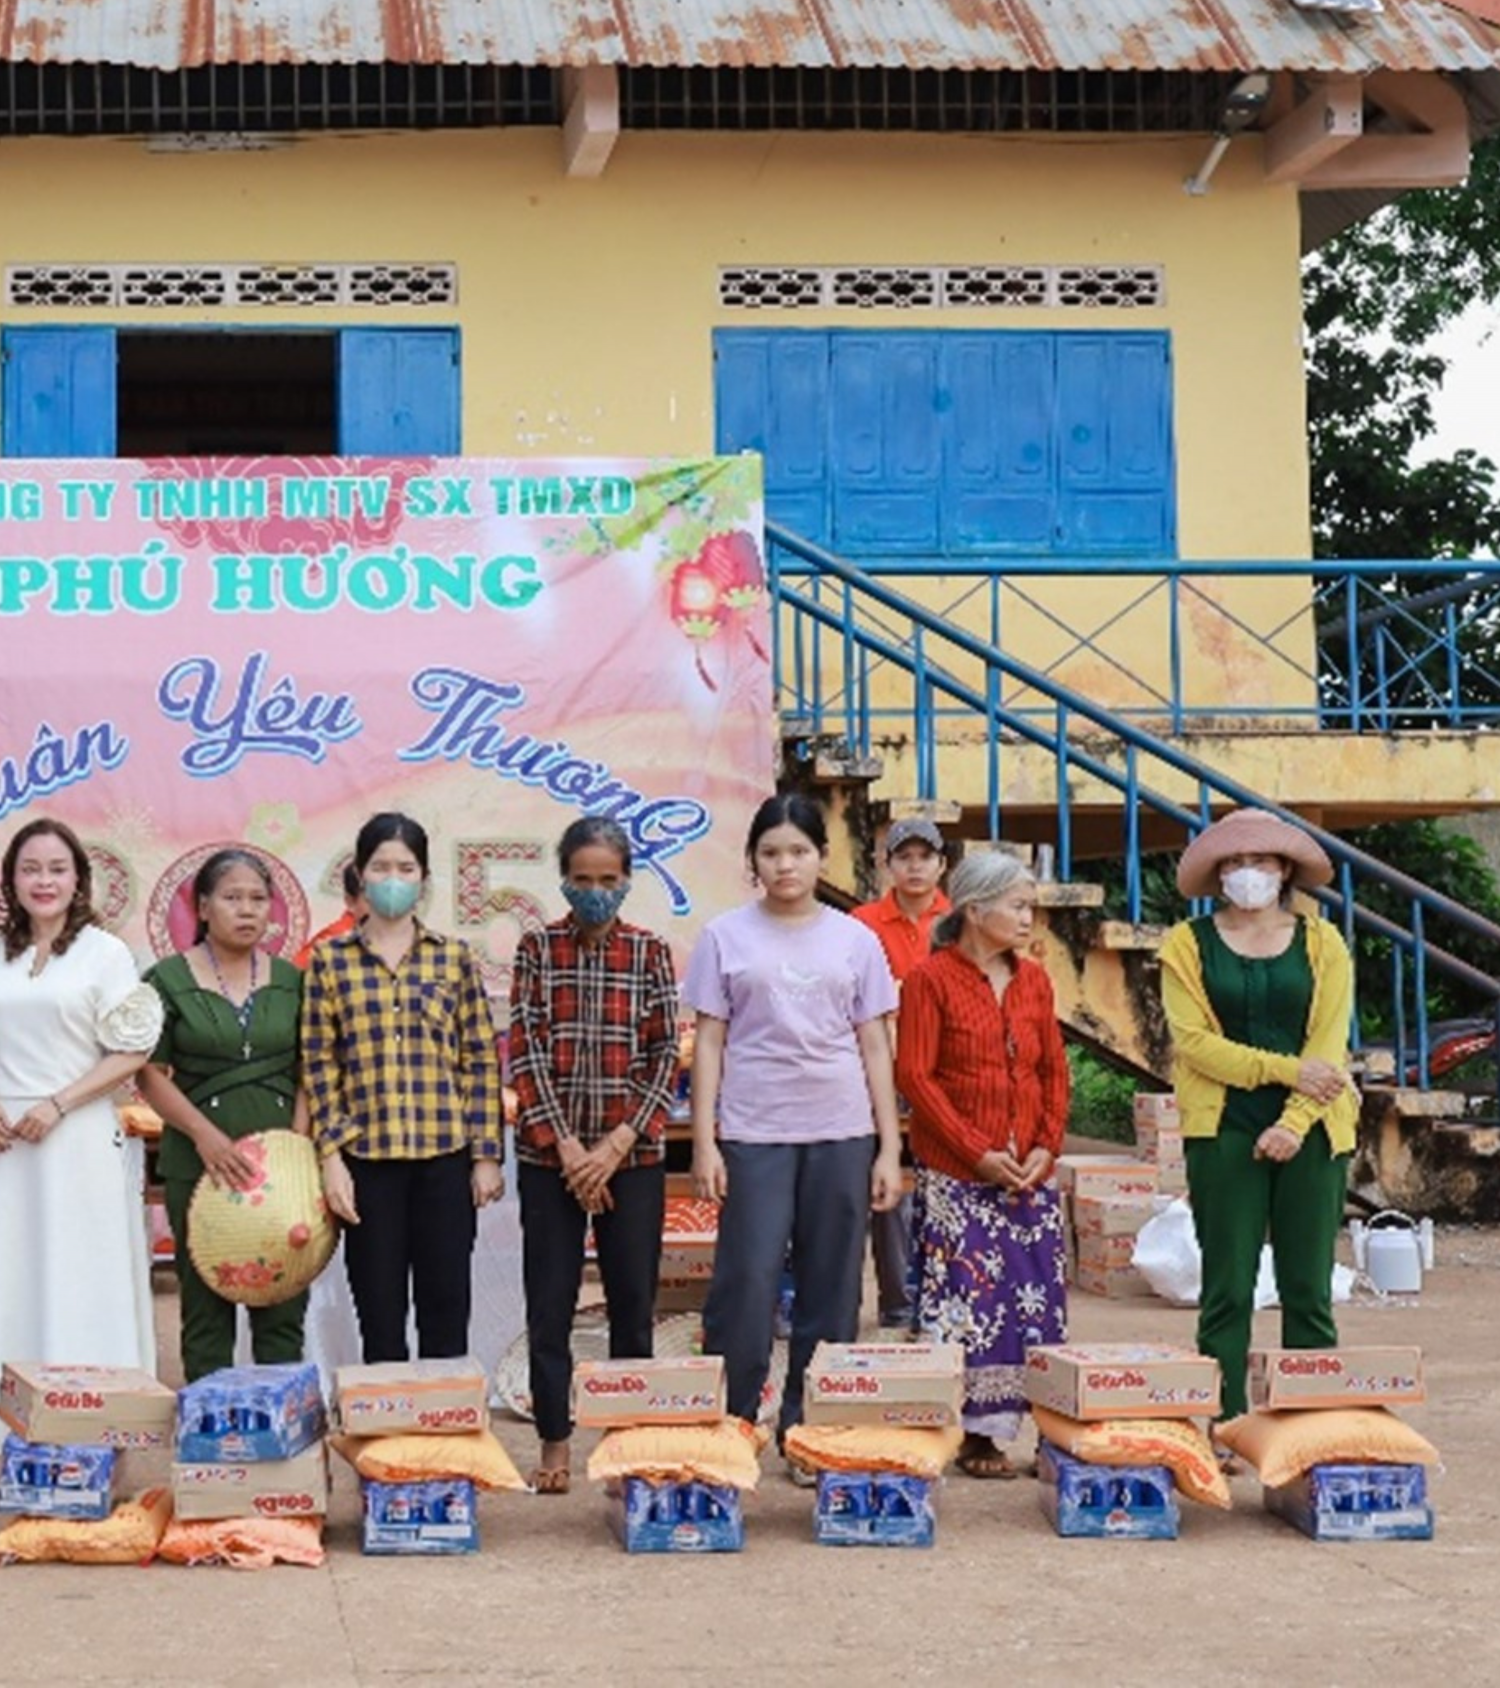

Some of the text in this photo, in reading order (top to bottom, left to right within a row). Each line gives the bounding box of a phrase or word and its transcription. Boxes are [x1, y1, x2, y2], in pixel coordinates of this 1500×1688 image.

[57, 481, 115, 520] TY
[133, 478, 268, 520] TNHH
[282, 477, 391, 519] MTV
[404, 477, 473, 518] SX
[489, 475, 636, 516] TMXD
[210, 544, 544, 613] HƯƠNG
[157, 649, 363, 777] Yêu
